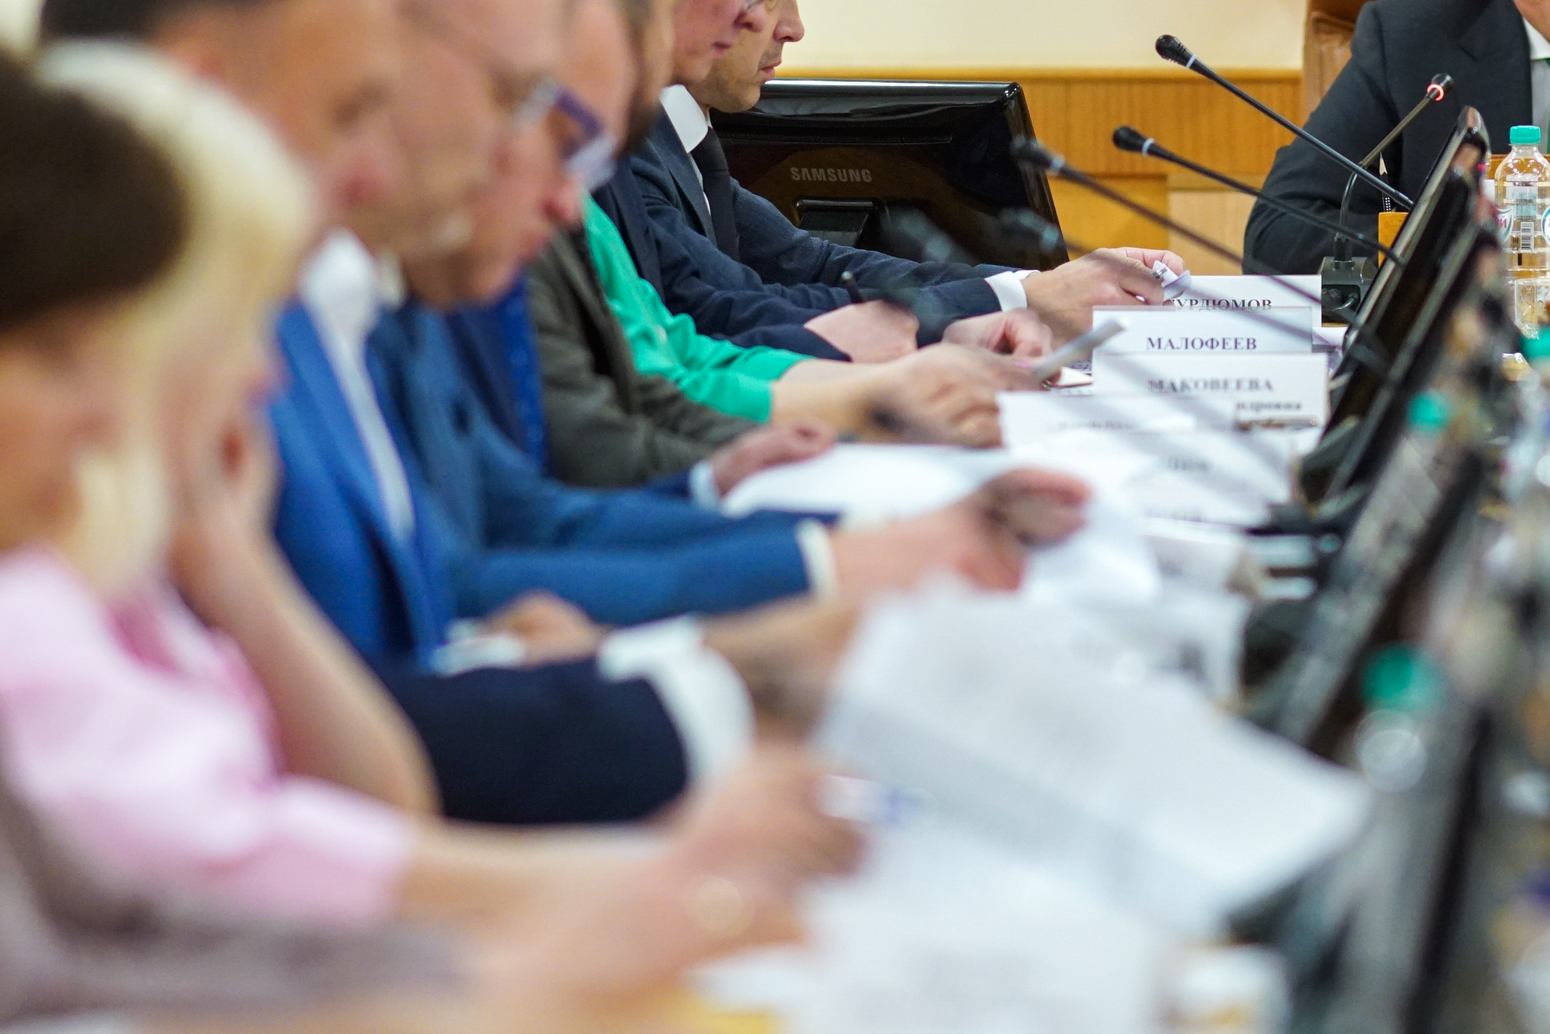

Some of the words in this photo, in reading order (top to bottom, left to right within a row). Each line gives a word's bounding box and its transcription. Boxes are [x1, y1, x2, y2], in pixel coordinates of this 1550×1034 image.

[790, 167, 872, 182] SAMSUNG
[1171, 298, 1272, 311] УРДЮМОВ
[1146, 337, 1257, 350] МАЛОФЕЕВ
